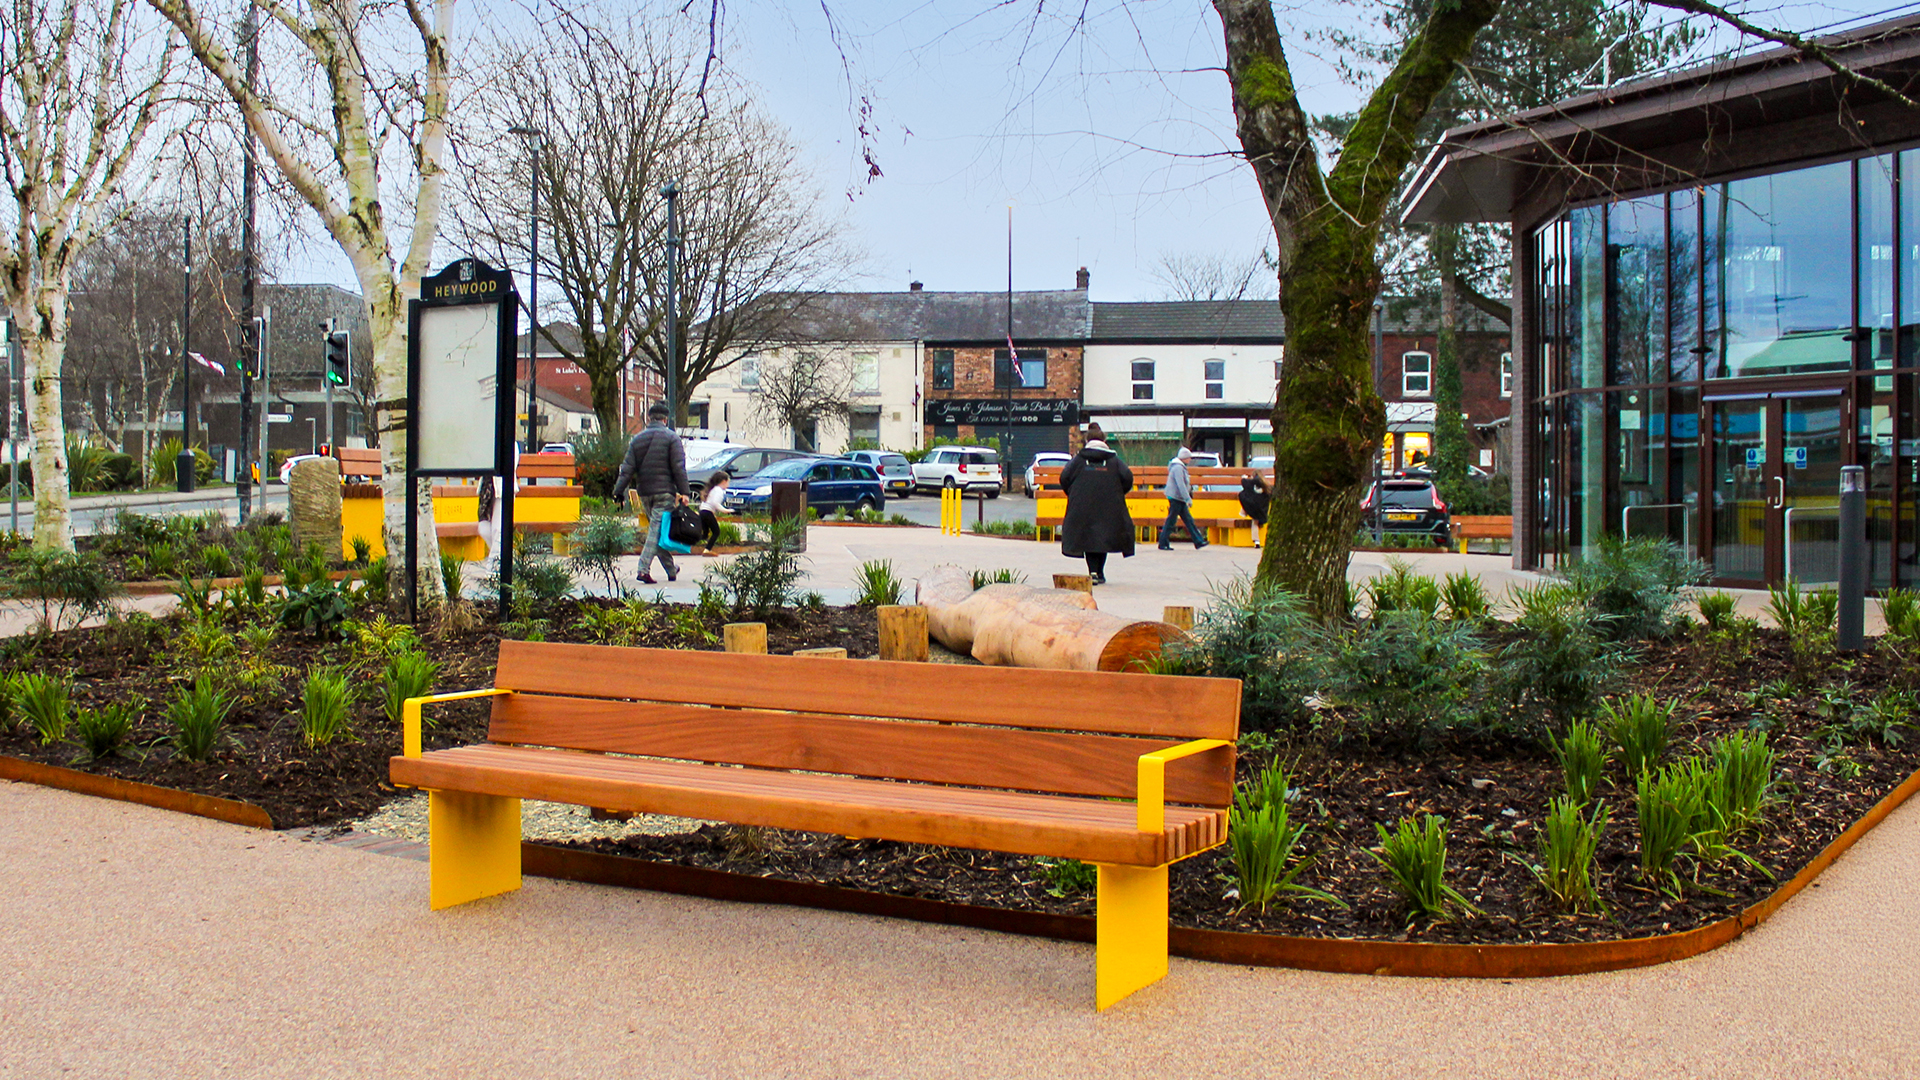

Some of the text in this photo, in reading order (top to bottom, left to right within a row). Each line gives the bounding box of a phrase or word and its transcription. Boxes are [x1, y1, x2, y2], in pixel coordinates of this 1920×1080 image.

[435, 280, 497, 297] HEYWOOD
[937, 402, 961, 415] Jones
[962, 402, 971, 411] &
[971, 402, 1003, 415] Johnson
[1029, 402, 1051, 412] Beds
[1052, 401, 1069, 413] Ltd
